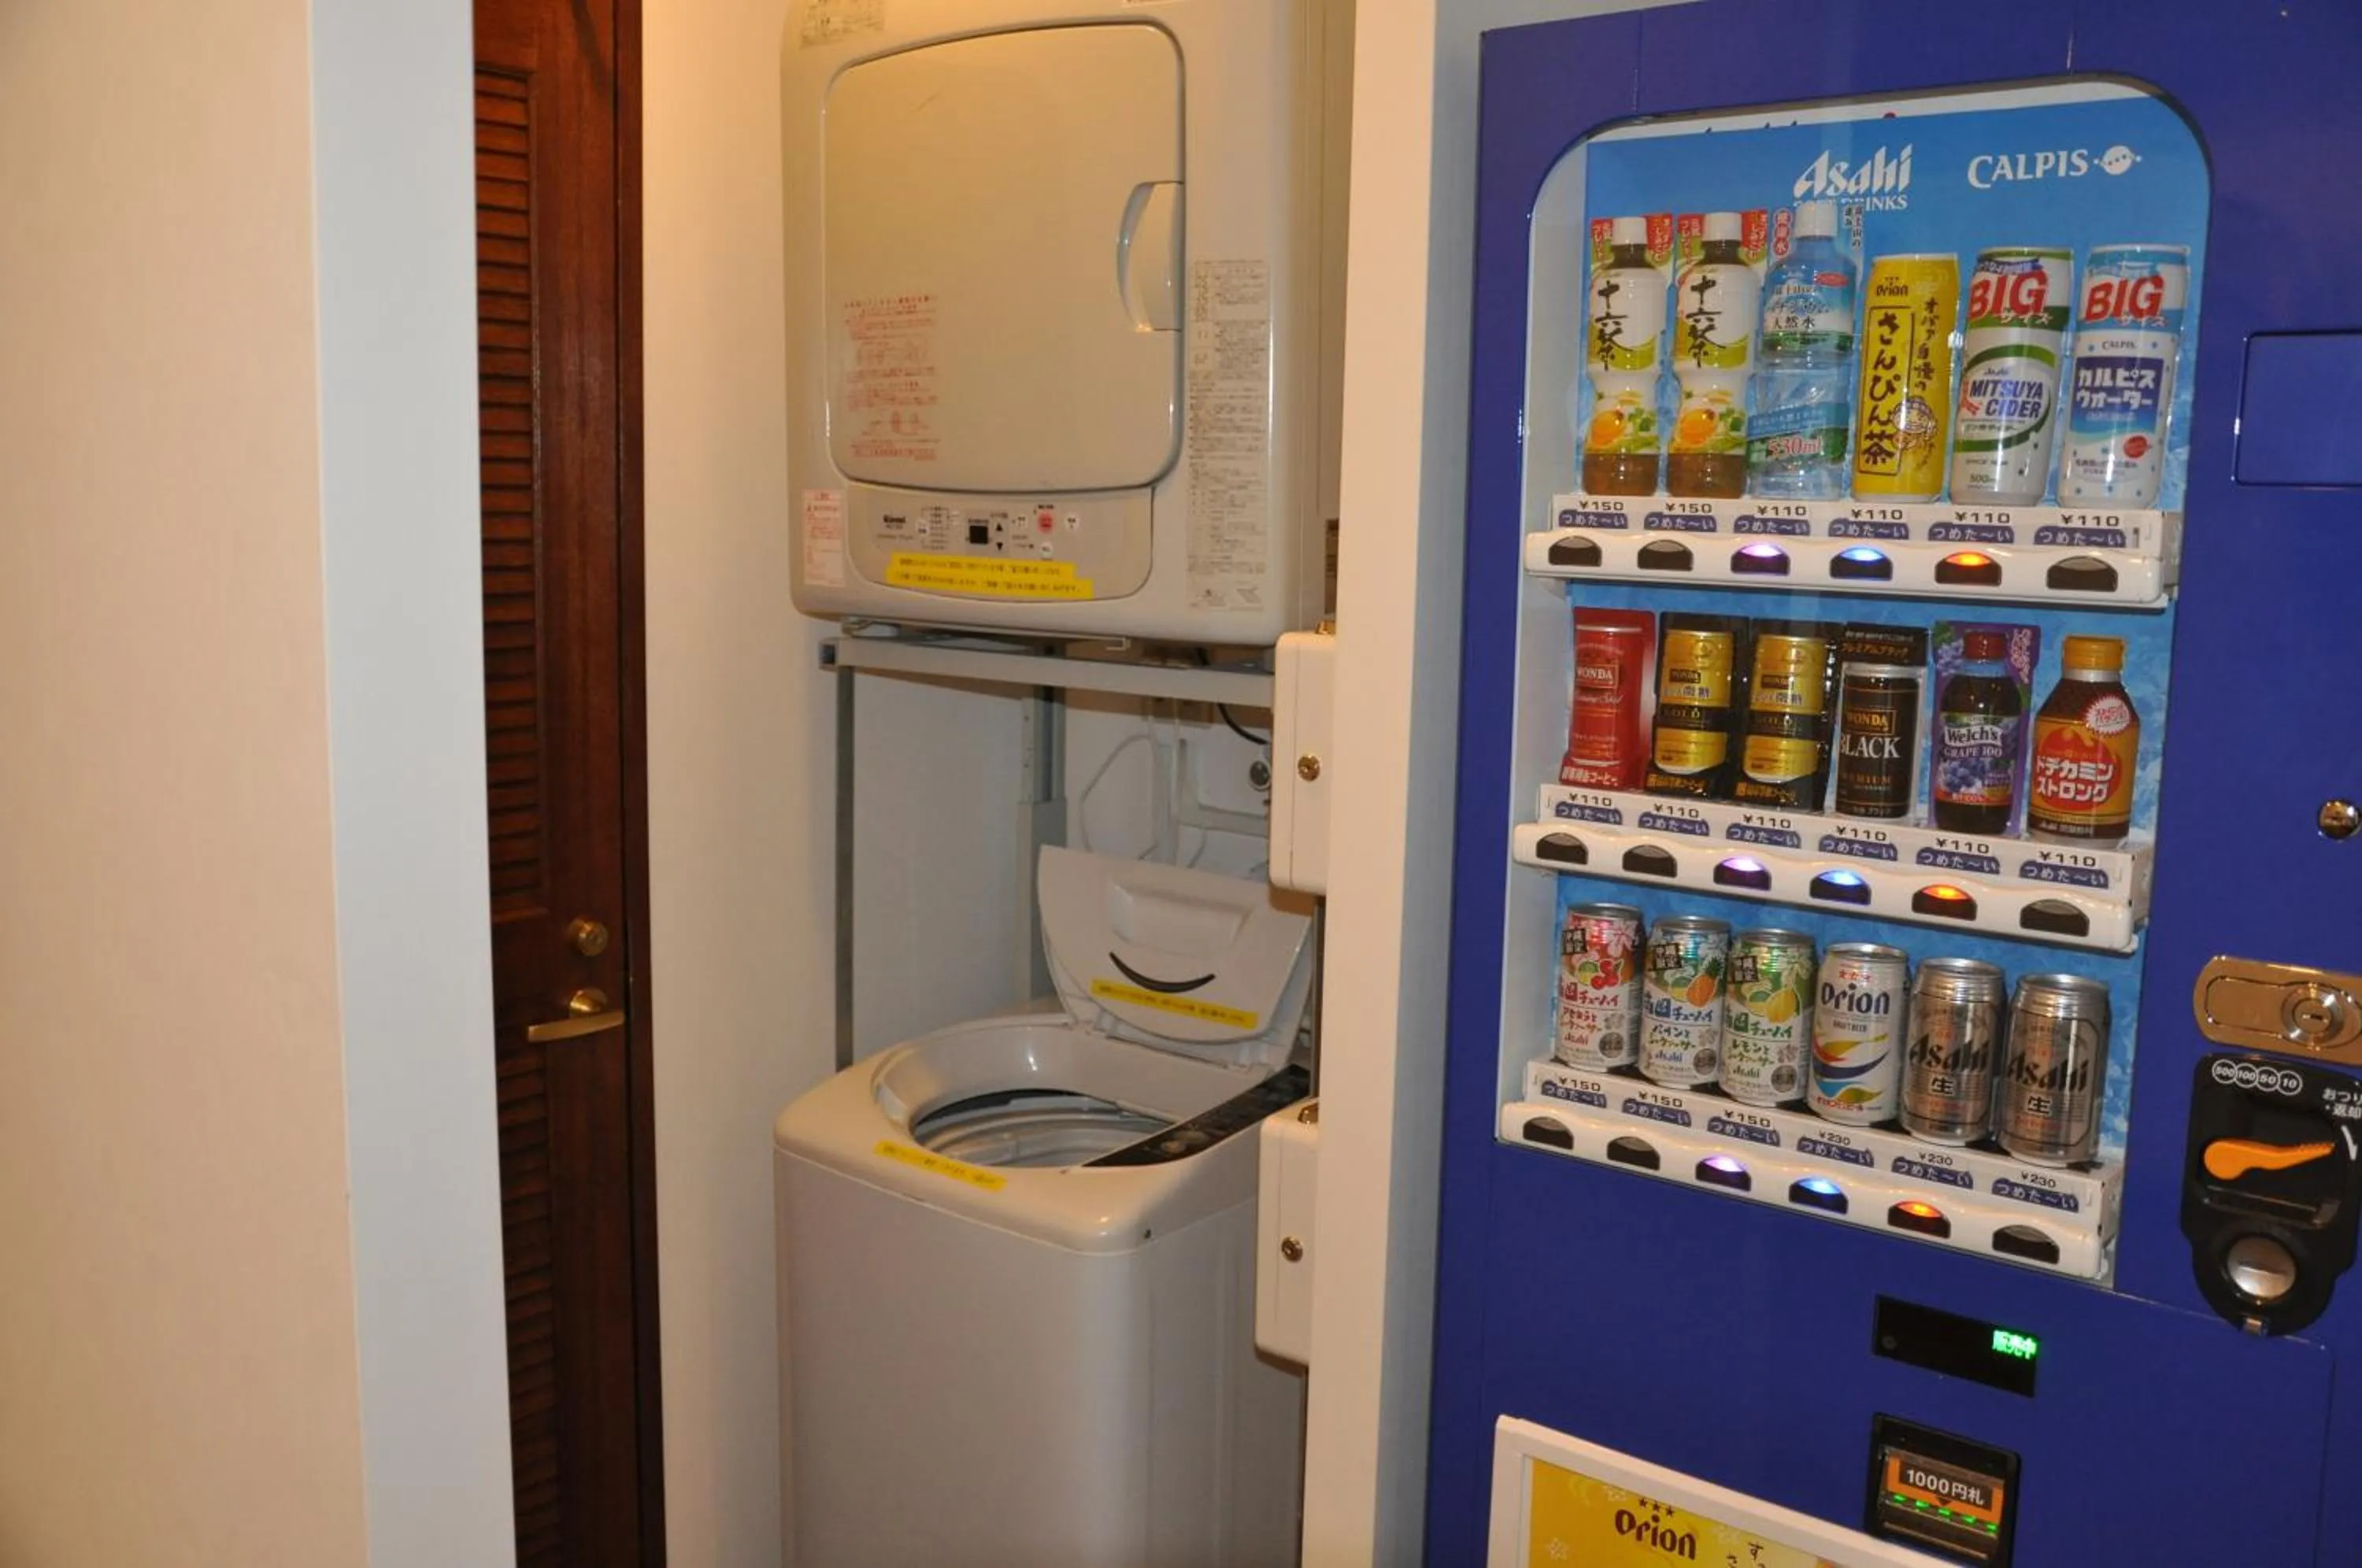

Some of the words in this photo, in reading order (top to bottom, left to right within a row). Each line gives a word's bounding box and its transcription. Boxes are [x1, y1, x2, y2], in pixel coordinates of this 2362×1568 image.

[1793, 143, 1913, 198] Asahi
[1968, 149, 2089, 189] CALPIS
[1968, 270, 2049, 320] BIG
[2085, 273, 2164, 322] BIG
[2078, 367, 2156, 388] カルピス
[1969, 379, 2044, 401] MITSUYA
[1985, 398, 2042, 418] CIDER
[1579, 500, 1624, 511] ¥150
[1665, 502, 1712, 513] ¥150
[1757, 505, 1807, 516] ¥110
[1851, 508, 1903, 520] ¥110
[1955, 512, 2010, 523] ¥110
[2060, 514, 2120, 527] ¥110
[1946, 727, 1999, 743] Welch's
[1944, 746, 1981, 757] GRAPE
[2036, 755, 2114, 782] ドデカミン
[2037, 778, 2109, 803] ストロング
[1568, 793, 1612, 807] ¥110
[1653, 804, 1700, 819] ¥110
[1742, 813, 1791, 829] ¥110
[1836, 825, 1887, 841] ¥110
[1935, 838, 1990, 854] ¥110
[2038, 851, 2097, 867] ¥110
[1820, 982, 1890, 1015] Orion
[2008, 1050, 2090, 1092] Asahi
[2215, 1066, 2236, 1078] 500
[2237, 1070, 2256, 1082] 100
[1559, 1076, 1601, 1092] ¥150
[1931, 1077, 1954, 1094] 生
[2259, 1074, 2276, 1085] 50
[2283, 1078, 2297, 1089] 10
[1638, 1091, 1683, 1108] ¥150
[2027, 1095, 2050, 1114] 生
[1723, 1109, 1771, 1127] ¥150
[1906, 1469, 1985, 1505] 1000円札
[1614, 1507, 1697, 1561] Orion
